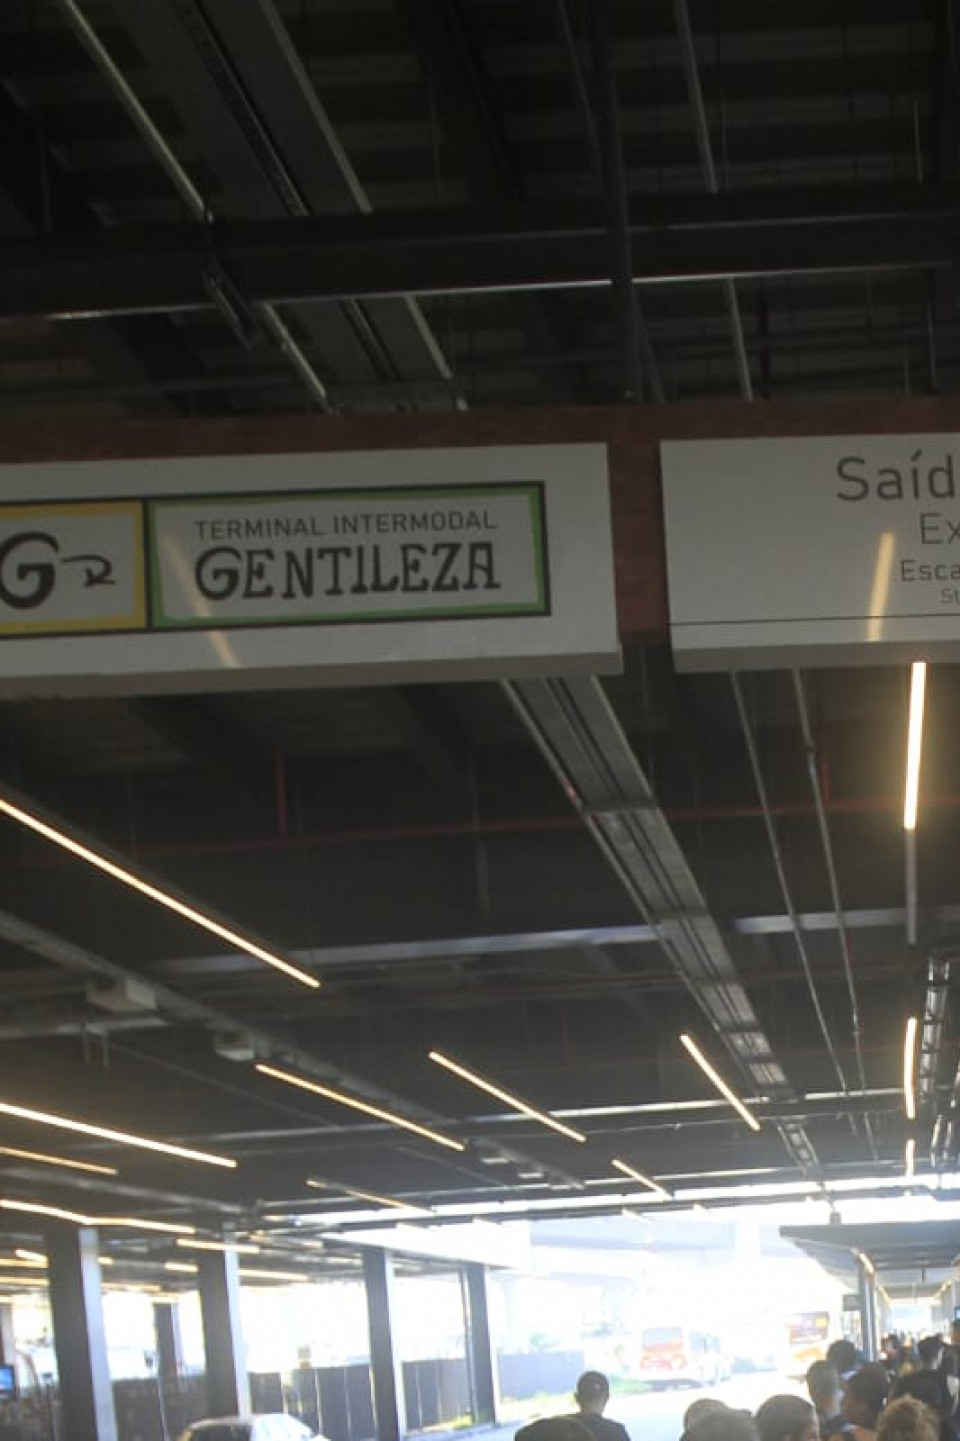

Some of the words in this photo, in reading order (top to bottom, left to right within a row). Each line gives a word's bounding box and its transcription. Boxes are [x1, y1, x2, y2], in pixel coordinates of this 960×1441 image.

[194, 516, 325, 540] TERMINAL
[333, 510, 499, 535] INTERMODAL
[0, 531, 59, 609] G
[195, 541, 501, 602] GENTILEZA
